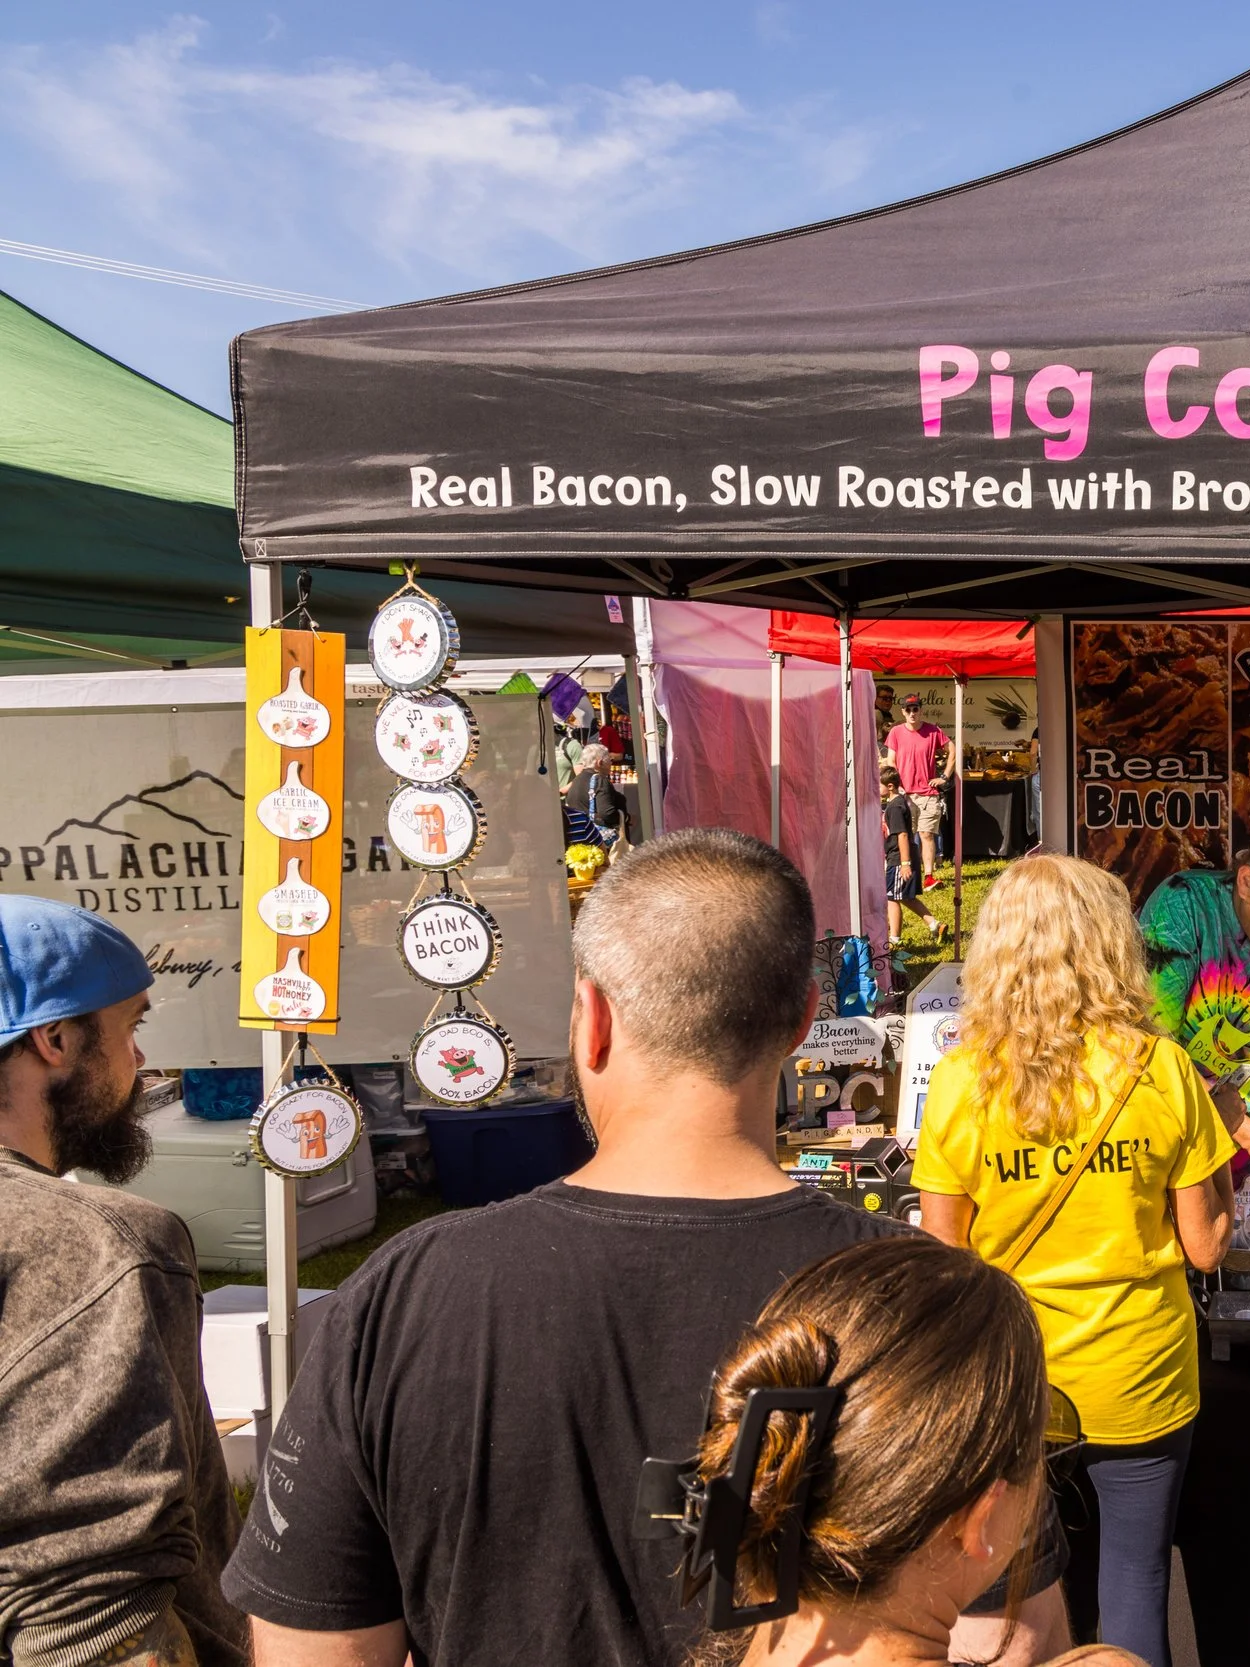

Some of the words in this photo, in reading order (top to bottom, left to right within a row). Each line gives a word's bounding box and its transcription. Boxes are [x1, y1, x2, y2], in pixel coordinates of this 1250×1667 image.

[919, 345, 1093, 460] Pig
[410, 466, 513, 509] Real
[533, 464, 688, 513] Bacon,
[711, 464, 820, 507] Slow
[839, 466, 1033, 510] Roasted
[1048, 467, 1152, 512] with
[409, 604, 433, 622] SHARE
[916, 689, 946, 707] ella
[1084, 747, 1227, 780] Real
[1084, 784, 1221, 830] BACON
[0, 841, 243, 882] PALACHI
[75, 885, 240, 913] DISTILL
[274, 889, 319, 899] SMASHED
[410, 914, 471, 939] THINK
[415, 935, 479, 959] BACON
[273, 977, 311, 989] NASHVILLE
[920, 998, 943, 1014] PIG
[421, 1039, 437, 1056] THIS
[439, 1027, 459, 1038] DAD
[462, 1027, 484, 1039] BOD
[802, 1038, 829, 1049] makes
[831, 1036, 875, 1048] everything
[814, 1023, 860, 1040] Bacon
[833, 1048, 859, 1056] better
[1192, 1040, 1209, 1062] Pig
[1212, 1056, 1232, 1075] Can
[439, 1087, 460, 1099] 100%
[464, 1075, 498, 1099] BACON
[279, 1094, 303, 1112] CRAZY
[326, 1095, 348, 1114] BACON
[269, 1461, 294, 1494] 1776
